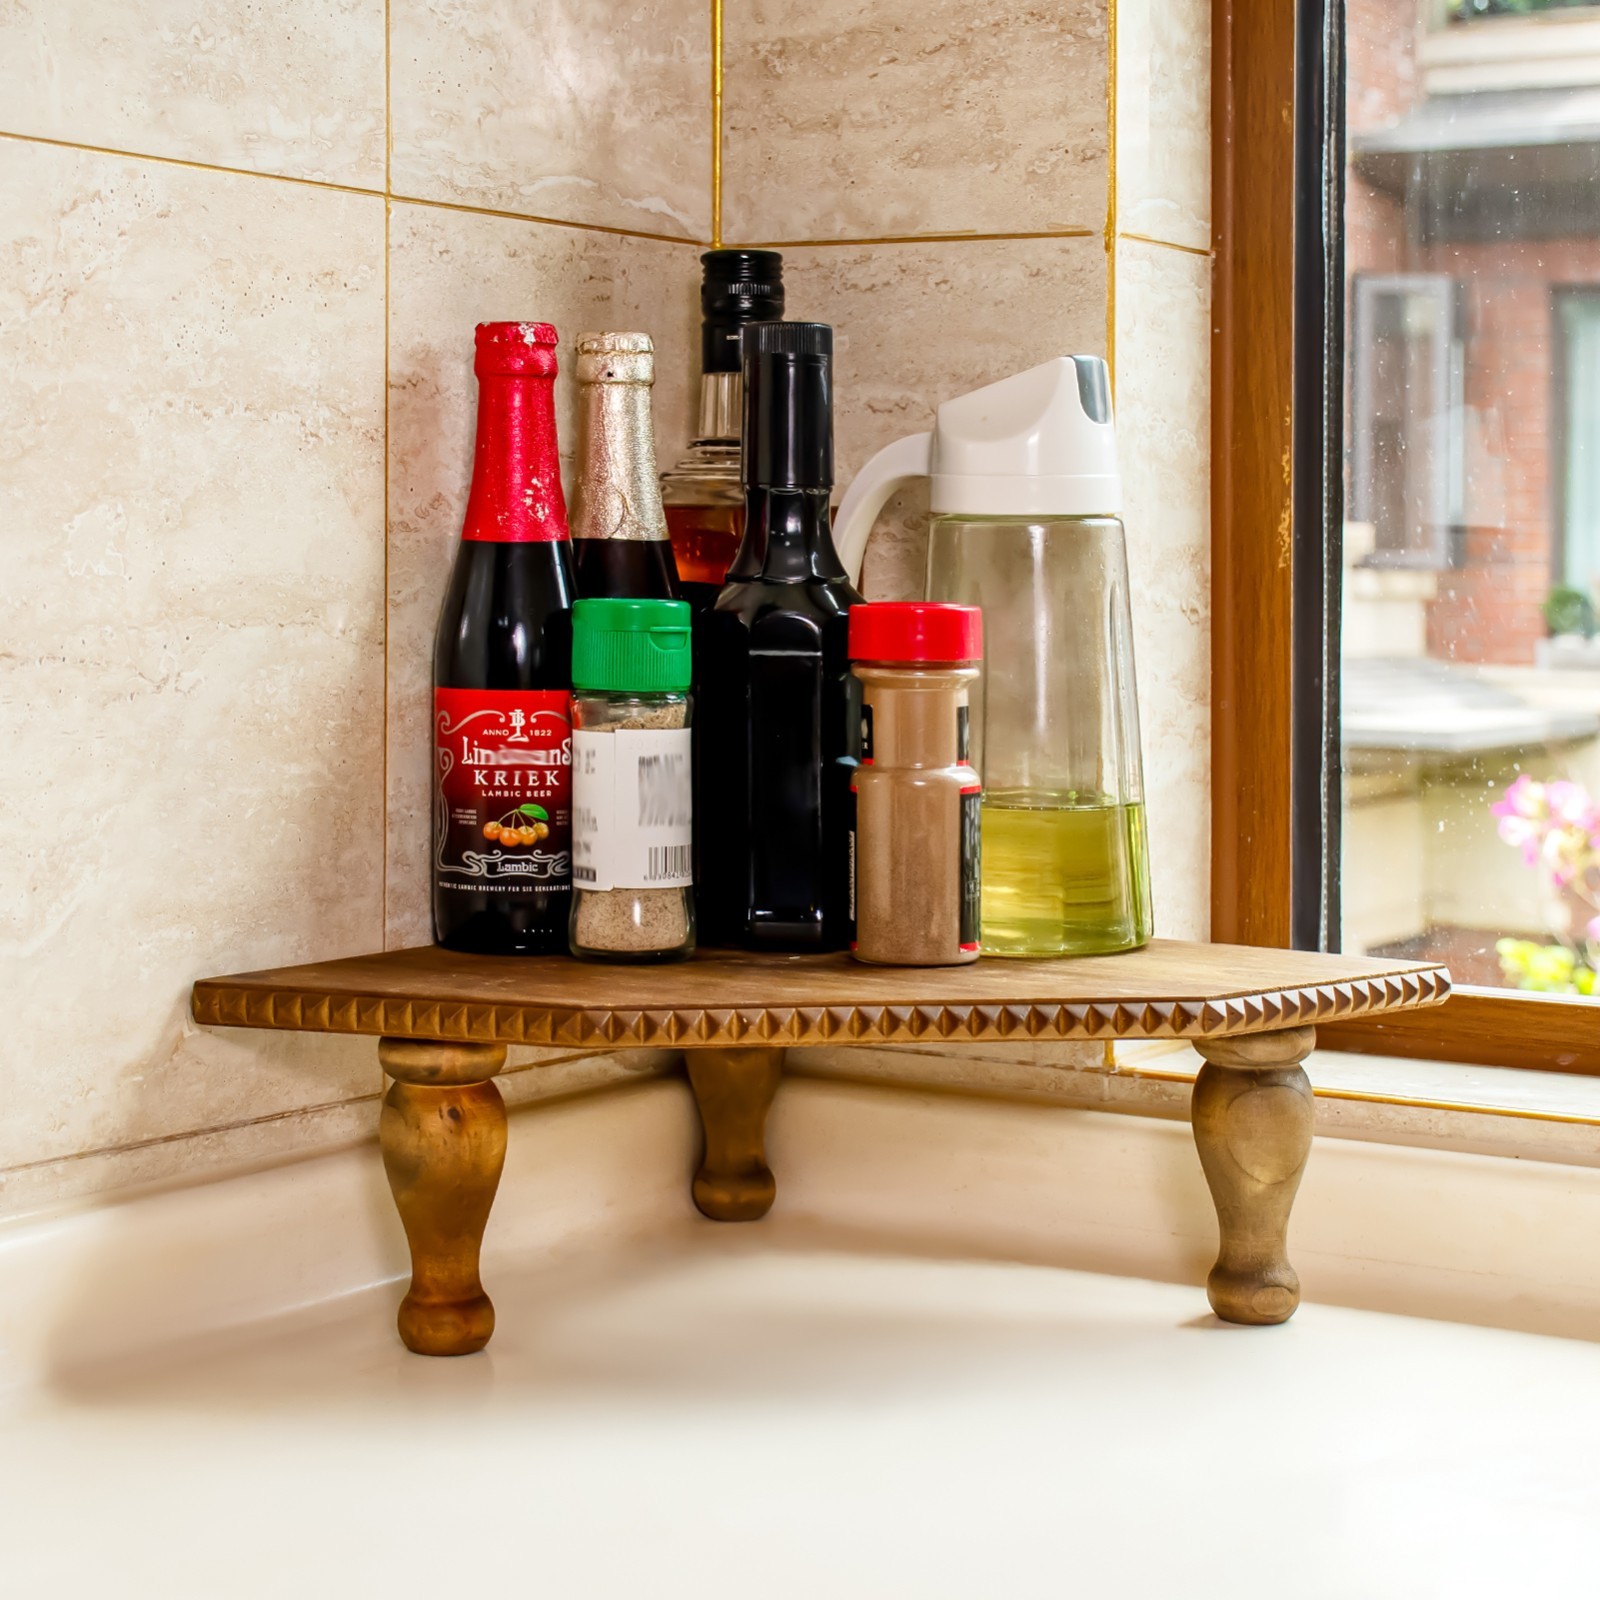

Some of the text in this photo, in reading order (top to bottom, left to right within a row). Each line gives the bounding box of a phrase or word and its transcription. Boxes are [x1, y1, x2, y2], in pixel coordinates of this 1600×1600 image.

[529, 729, 552, 737] 1822
[473, 769, 560, 786] KRIEK
[481, 789, 521, 797] LAMBIC
[496, 861, 539, 872] Lambic
